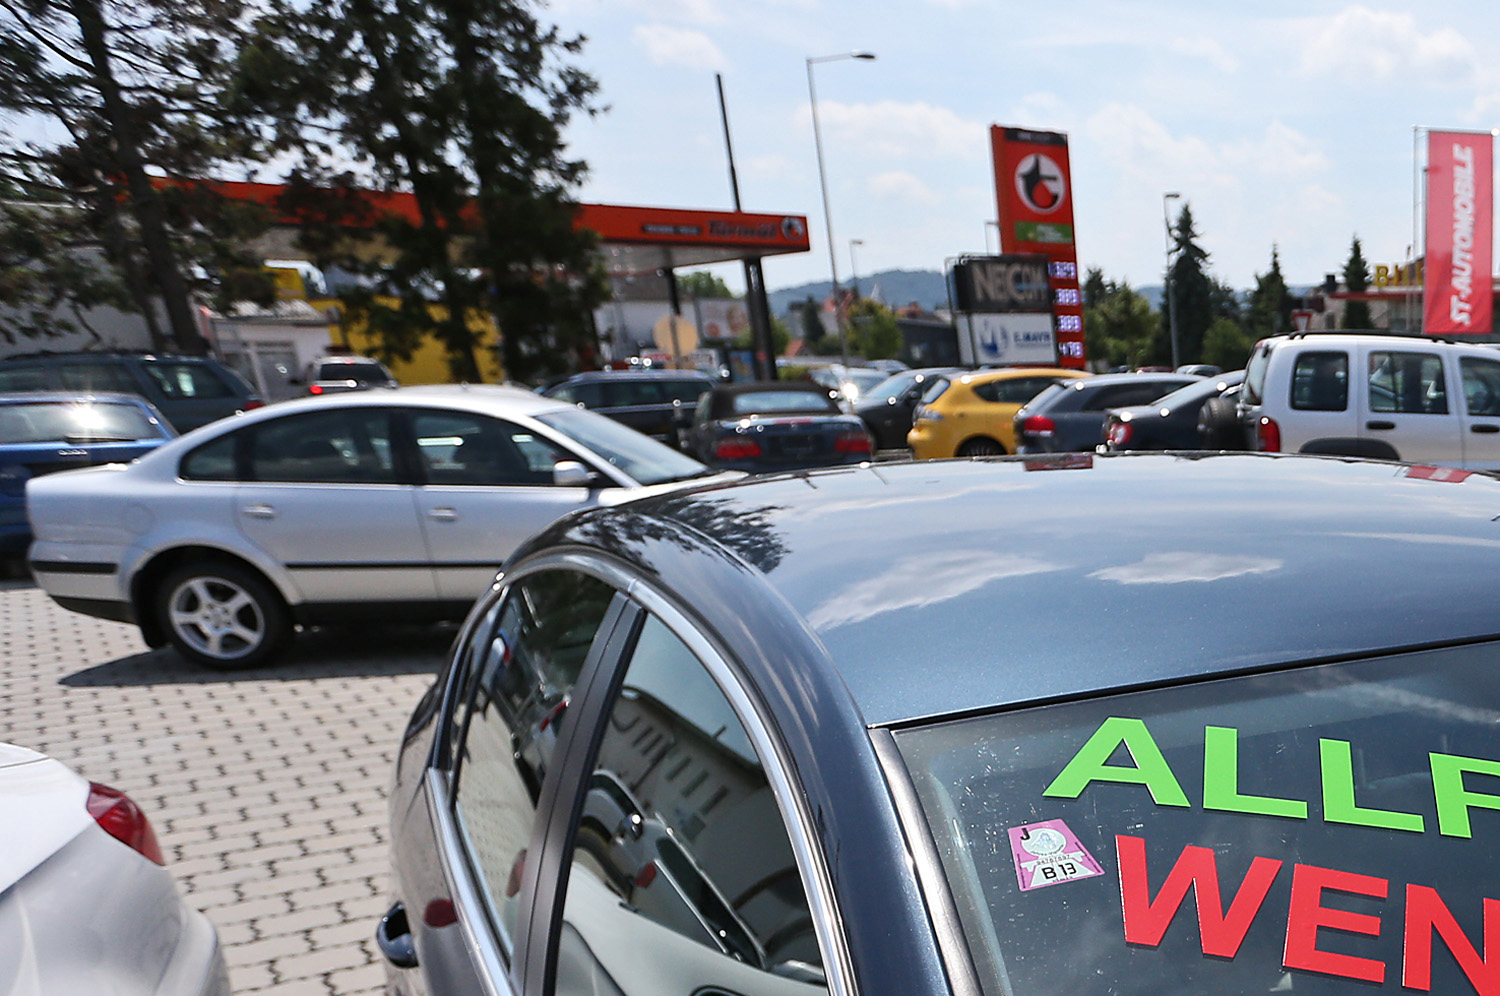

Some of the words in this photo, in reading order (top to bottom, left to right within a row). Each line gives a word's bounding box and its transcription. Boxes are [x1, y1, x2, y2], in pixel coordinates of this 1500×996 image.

[1449, 143, 1475, 326] ST-AUTOMOBILE
[1020, 828, 1030, 840] J
[1041, 866, 1057, 879] B
[1058, 862, 1077, 876] 13
